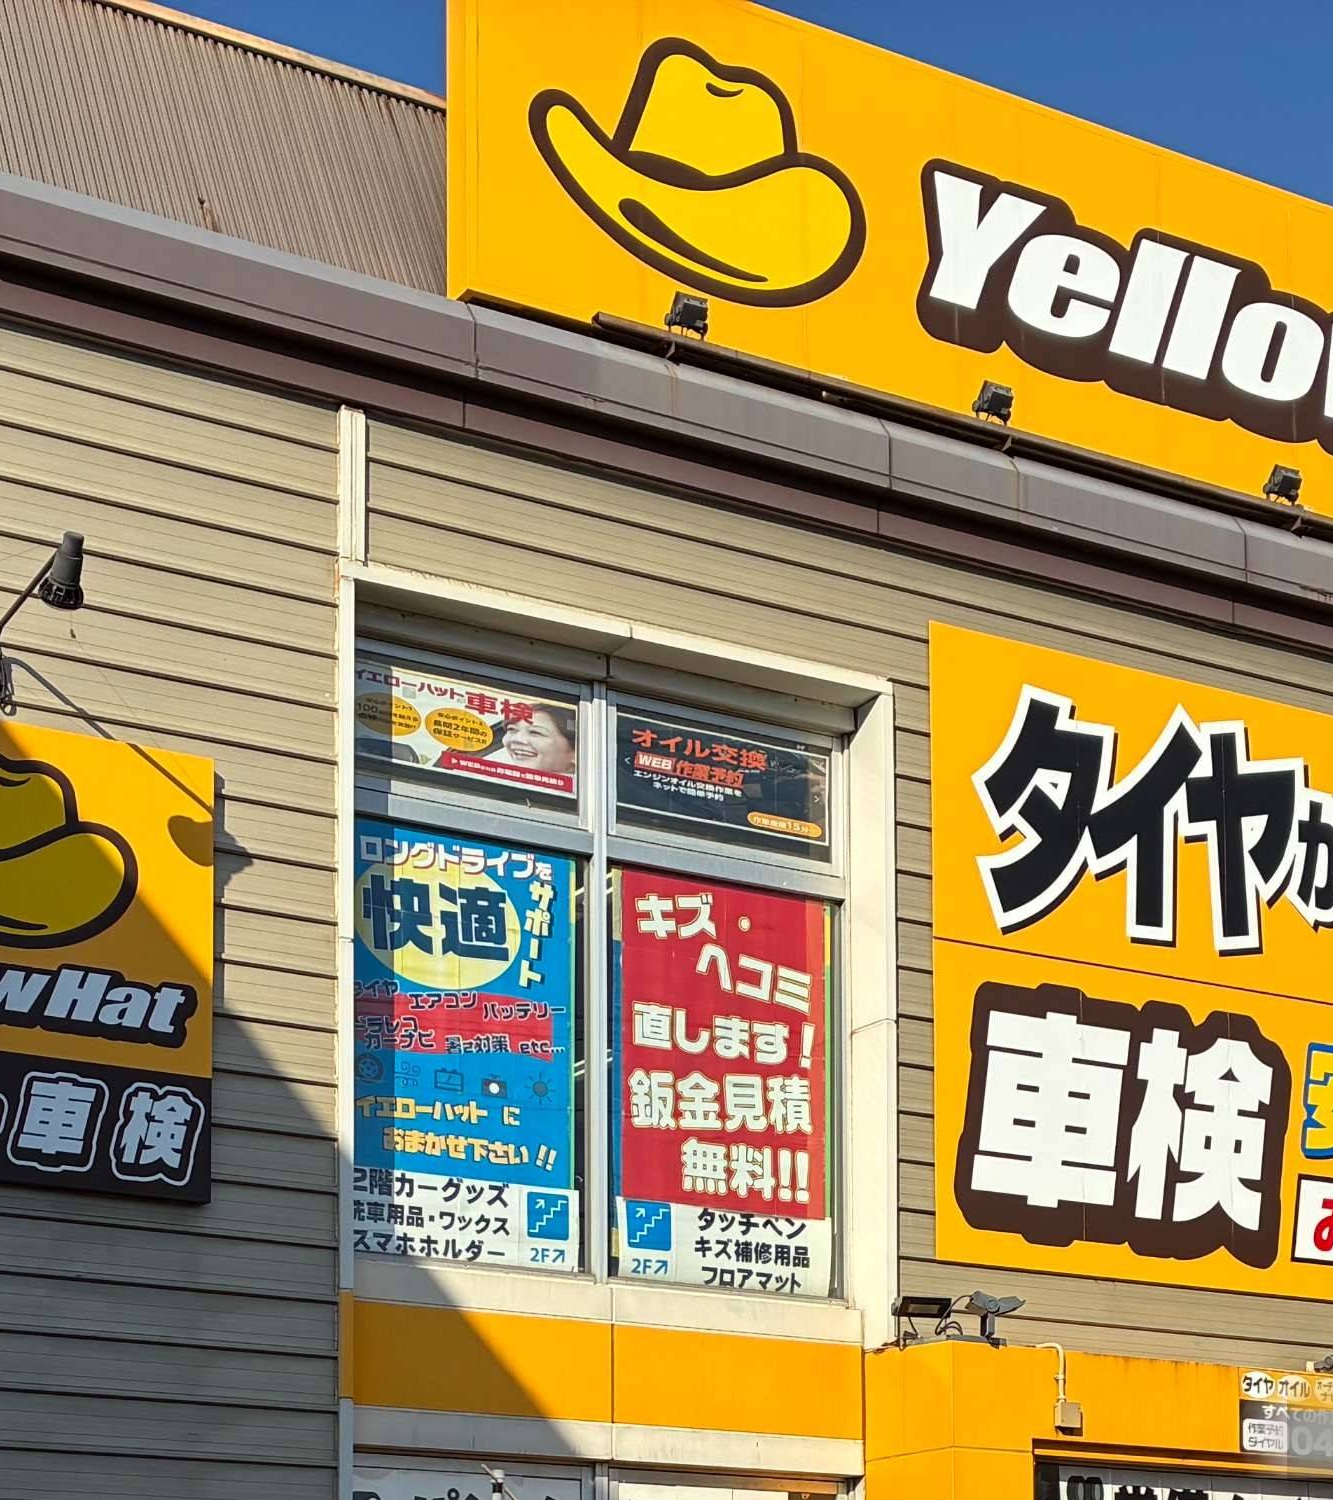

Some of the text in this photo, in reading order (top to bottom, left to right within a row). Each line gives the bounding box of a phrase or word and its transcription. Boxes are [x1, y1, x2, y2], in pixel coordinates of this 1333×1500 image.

[632, 729, 768, 771] オイル交換
[359, 834, 554, 881] ロングドライブを
[362, 873, 510, 962] 快適
[518, 880, 555, 988] サポート
[408, 992, 478, 1010] エアコン
[483, 1001, 566, 1021] バッテリー
[364, 1030, 436, 1051] カーナビ
[632, 1000, 815, 1069] 直します!
[355, 1095, 521, 1126] イエローハット に
[628, 1067, 813, 1136] 鈑金見積
[965, 1006, 1279, 1236] 車検
[697, 1208, 807, 1240] タッチペン
[353, 1229, 506, 1263] スマホホルダー
[530, 1247, 550, 1264] 2F
[693, 1236, 811, 1269] キズ補修用品
[631, 1257, 652, 1275] 2F
[701, 1266, 802, 1294] フロアマット
[1242, 1375, 1274, 1394] タイヤ
[1278, 1377, 1310, 1398] オイル
